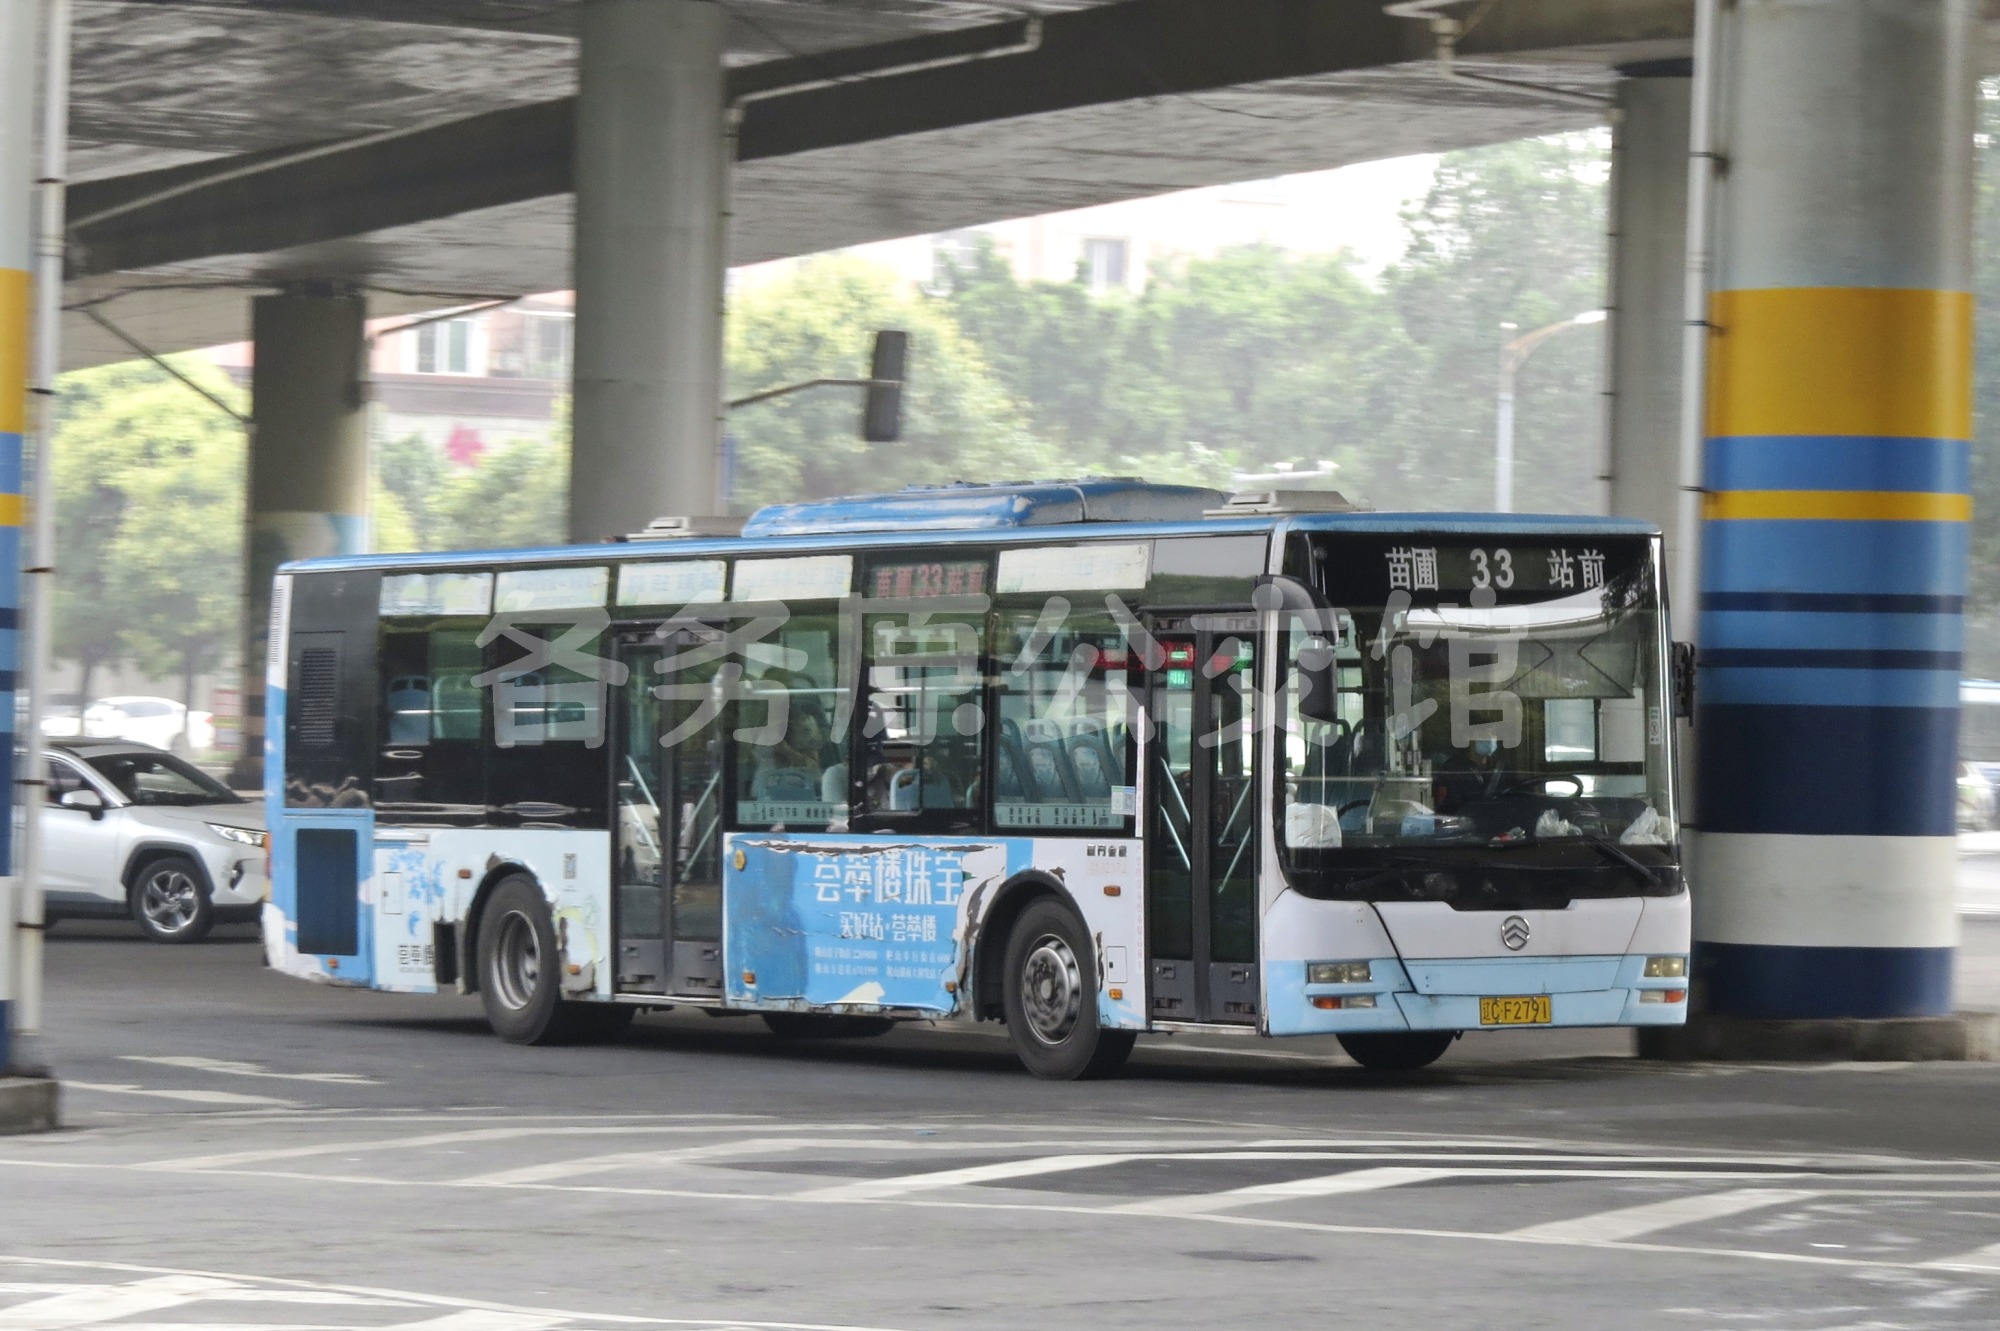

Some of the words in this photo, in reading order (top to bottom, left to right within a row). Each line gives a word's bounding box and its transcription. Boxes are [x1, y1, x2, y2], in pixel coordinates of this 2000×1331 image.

[1385, 547, 1439, 591] 苗圃
[1470, 548, 1514, 588] 33
[1547, 549, 1605, 588] 站前
